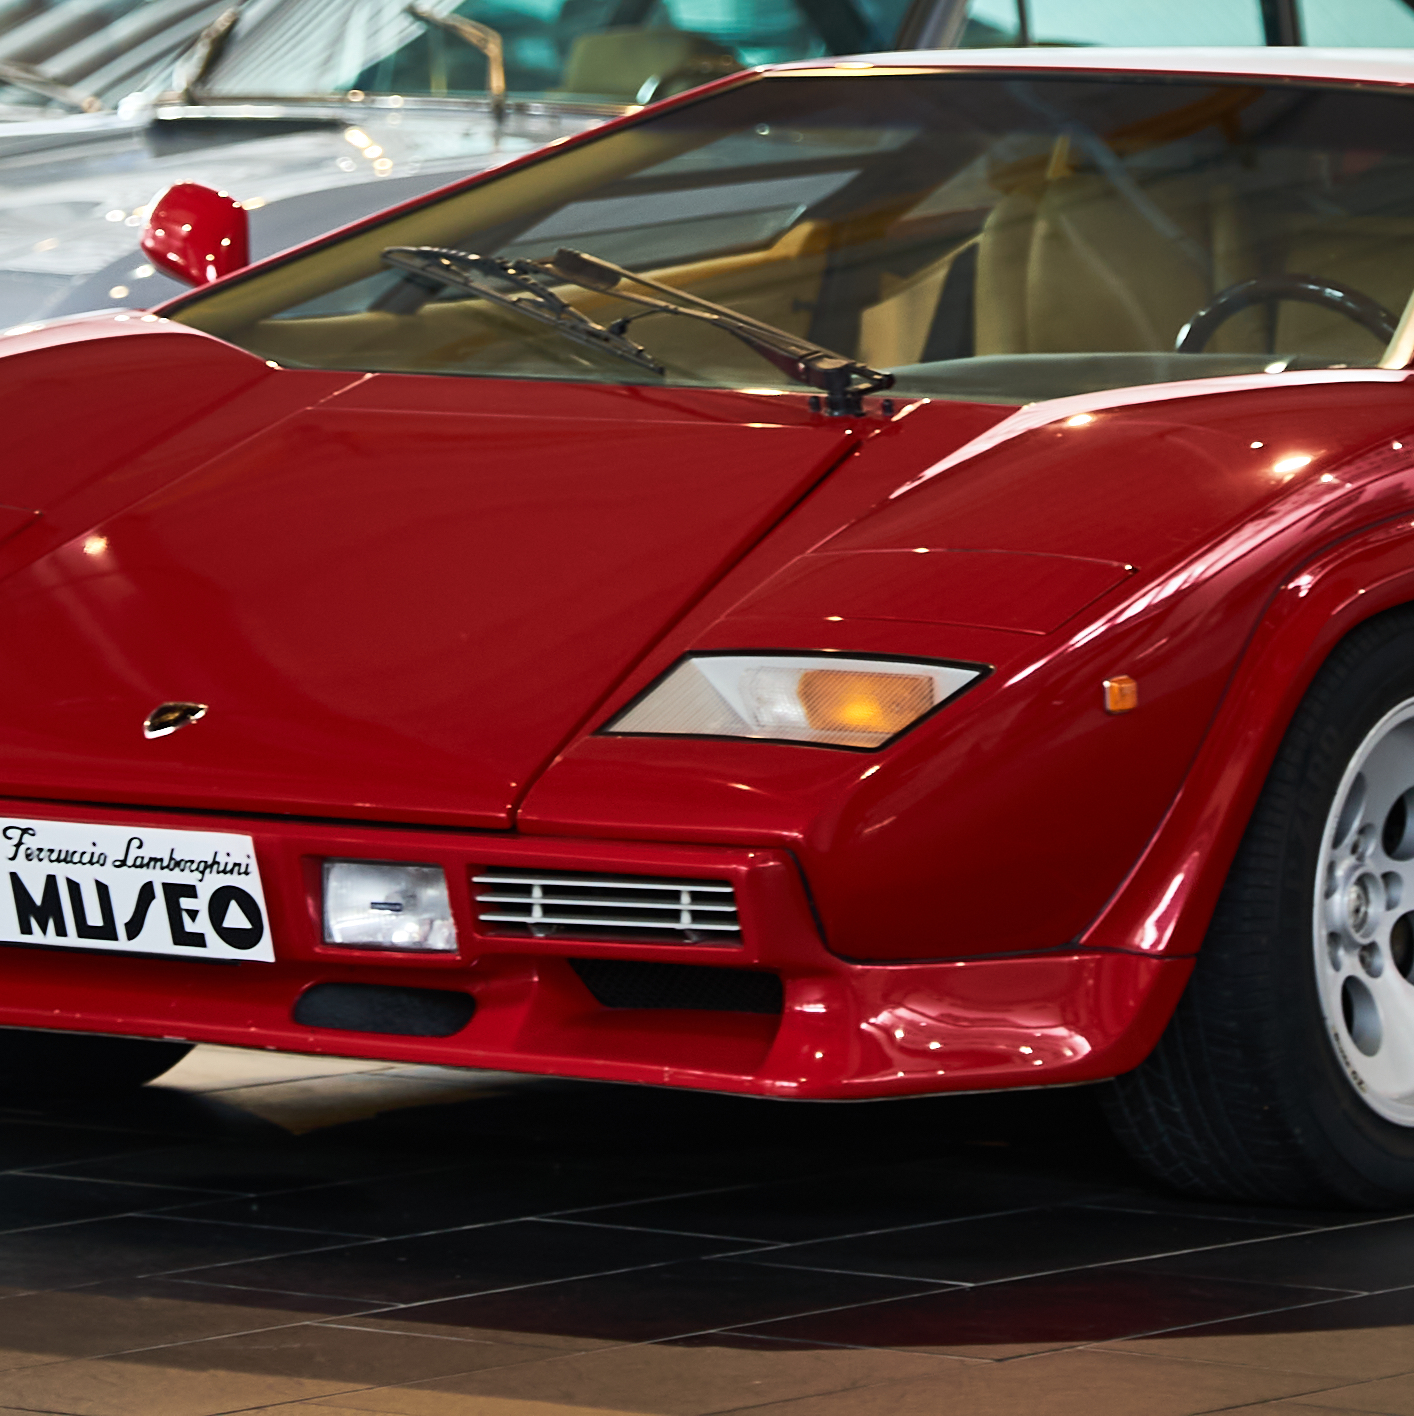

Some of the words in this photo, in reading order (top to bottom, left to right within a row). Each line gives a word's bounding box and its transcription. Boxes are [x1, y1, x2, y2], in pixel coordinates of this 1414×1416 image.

[2, 825, 107, 862] Ferruccio
[112, 836, 252, 882] Lamborghini
[8, 871, 264, 950] MUSEO
